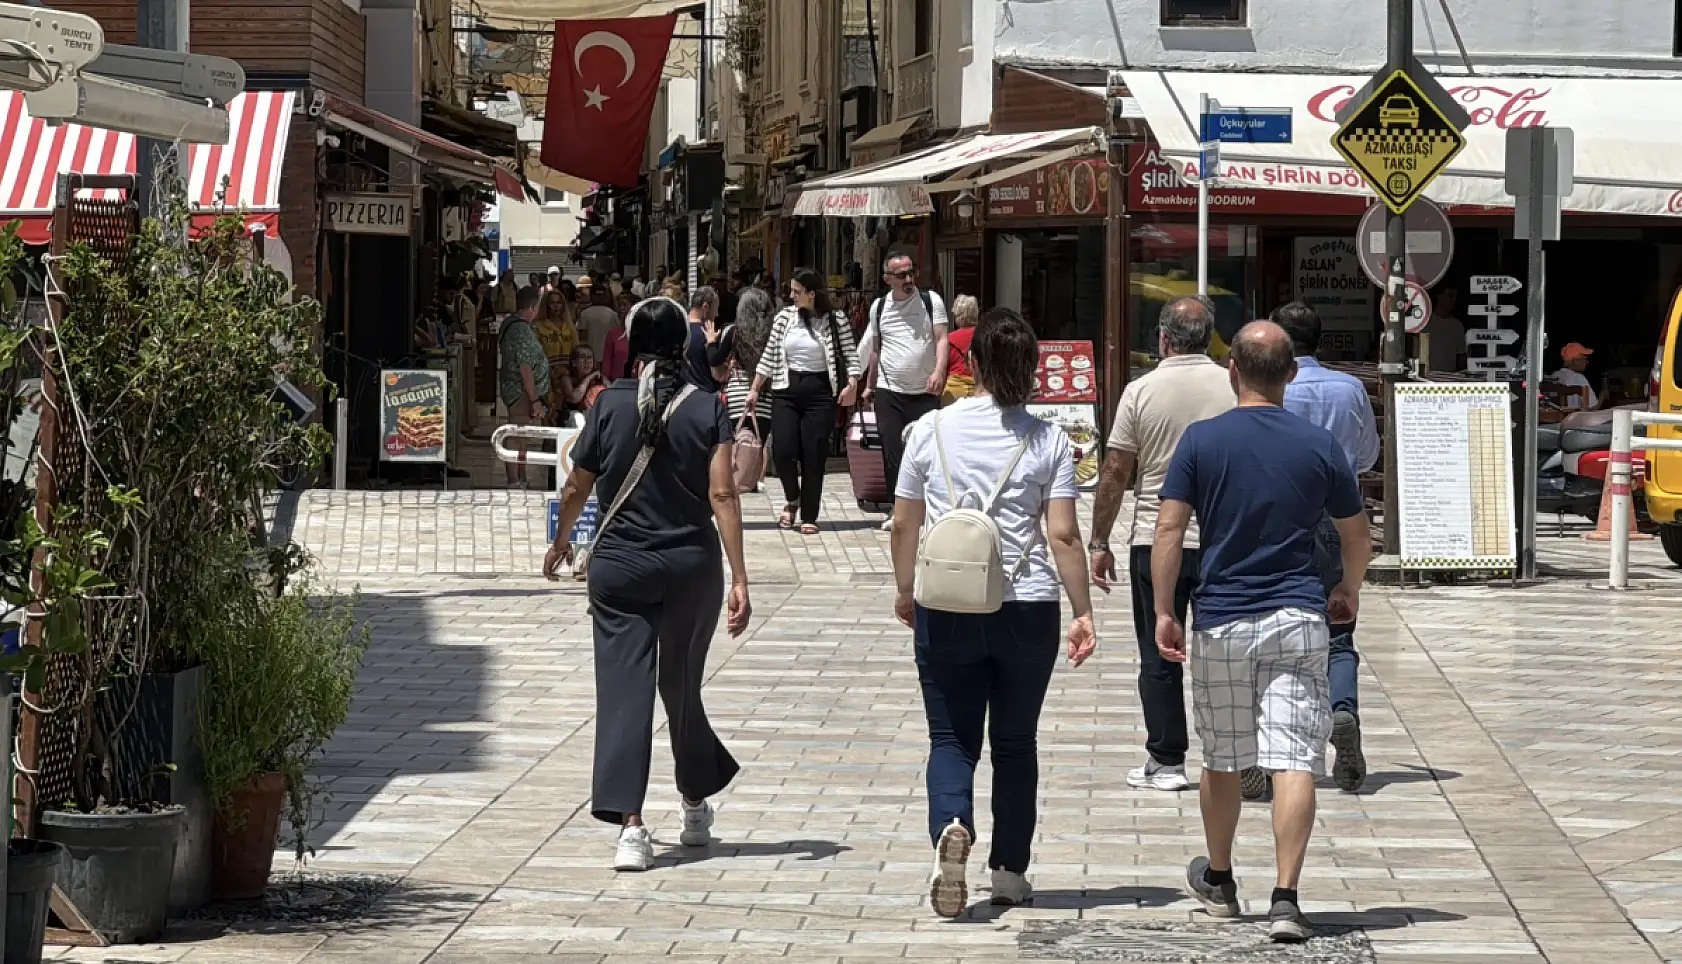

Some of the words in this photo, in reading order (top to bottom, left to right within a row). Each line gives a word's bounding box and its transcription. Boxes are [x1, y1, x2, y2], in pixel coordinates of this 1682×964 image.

[60, 27, 92, 40] BURCU
[64, 38, 94, 52] TENTE
[212, 78, 237, 90] TENTE
[1219, 116, 1266, 130] Üçkuyular
[1364, 141, 1433, 158] AZMAKBAŞI
[1382, 156, 1417, 171] TAKSİ
[1262, 165, 1322, 185] ŞİRİN
[1141, 194, 1197, 207] Azmakbaşı
[1206, 195, 1256, 206] BODRUM
[328, 201, 405, 226] PIZZERIA
[384, 385, 442, 407] lasagne
